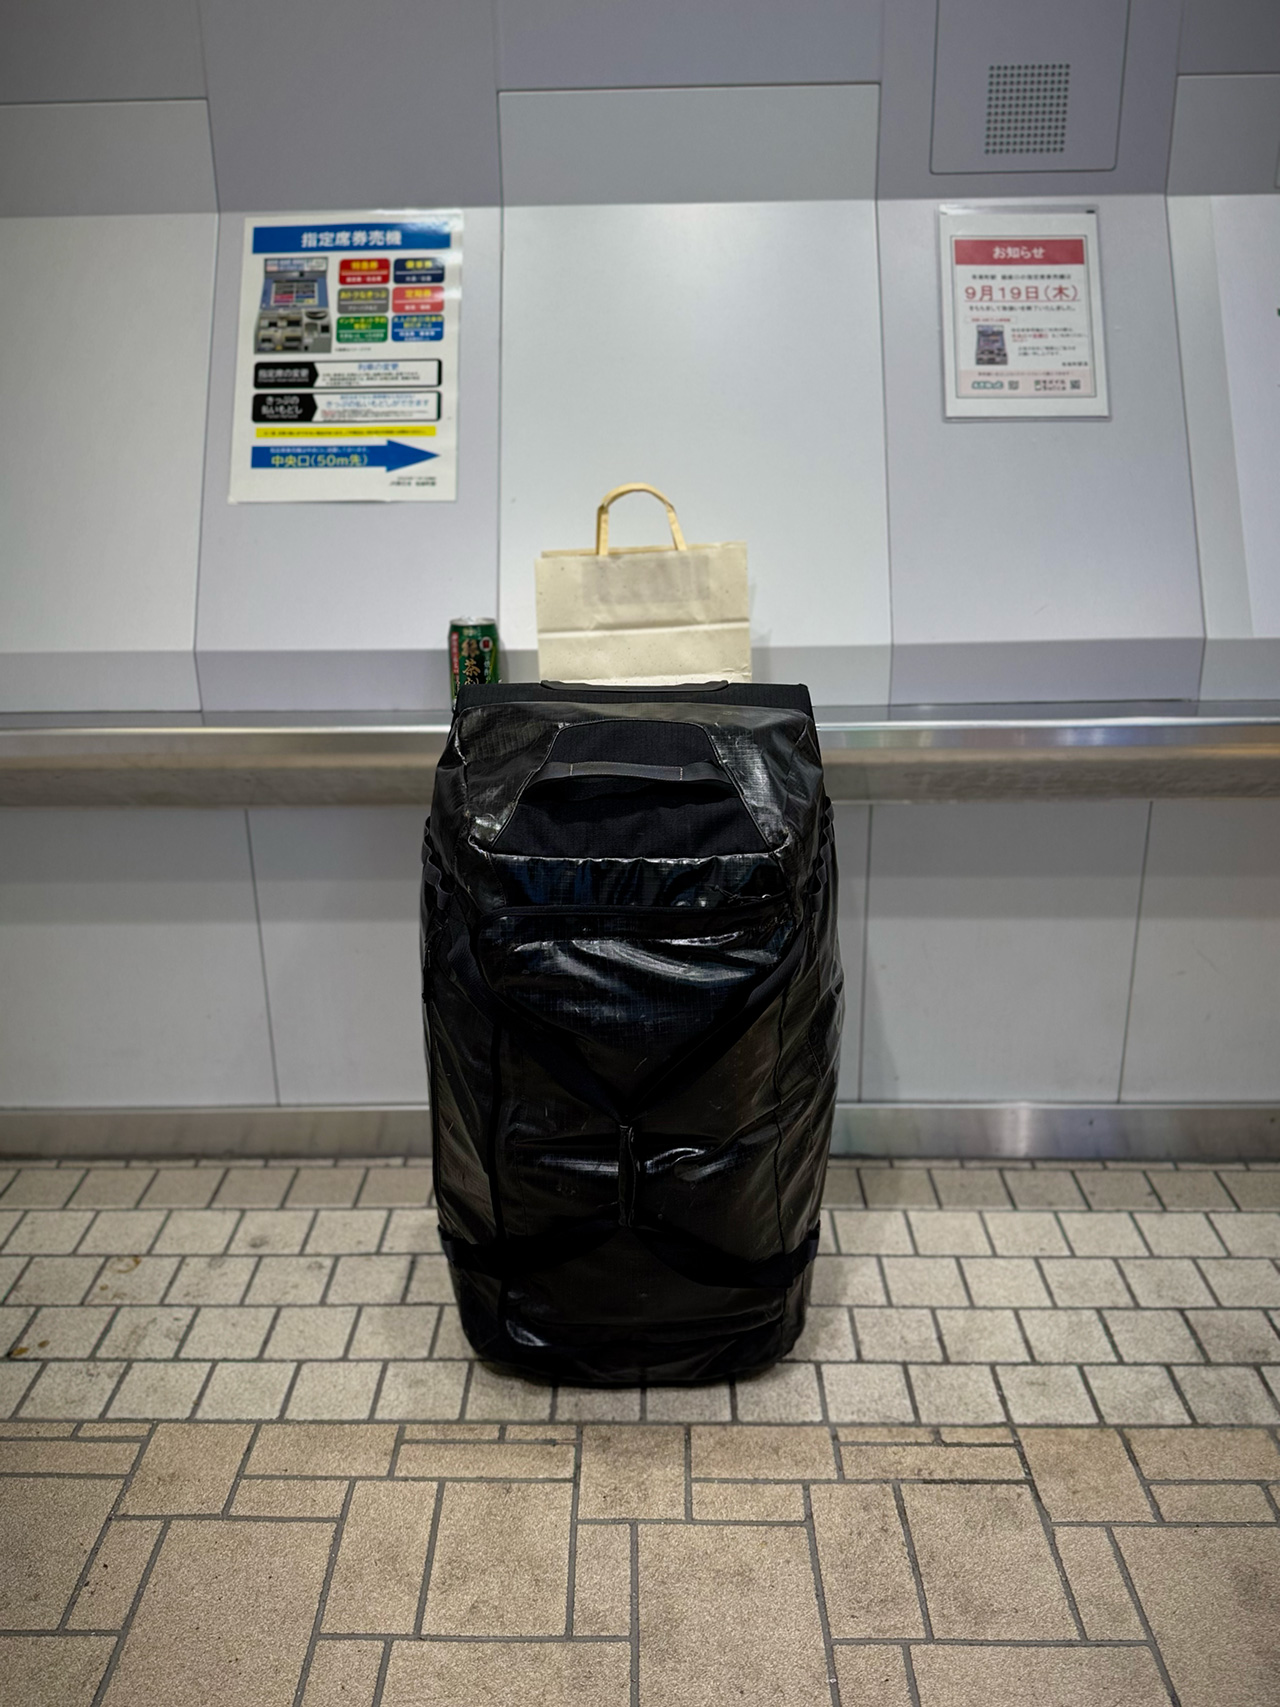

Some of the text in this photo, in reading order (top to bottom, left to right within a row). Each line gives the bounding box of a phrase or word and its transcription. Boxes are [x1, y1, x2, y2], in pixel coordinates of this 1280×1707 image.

[301, 231, 402, 248] 指定席券売機
[993, 246, 1045, 259] お知らせ
[965, 285, 1078, 301] 9月19日(木)
[271, 455, 368, 467] 中央口(50m先)
